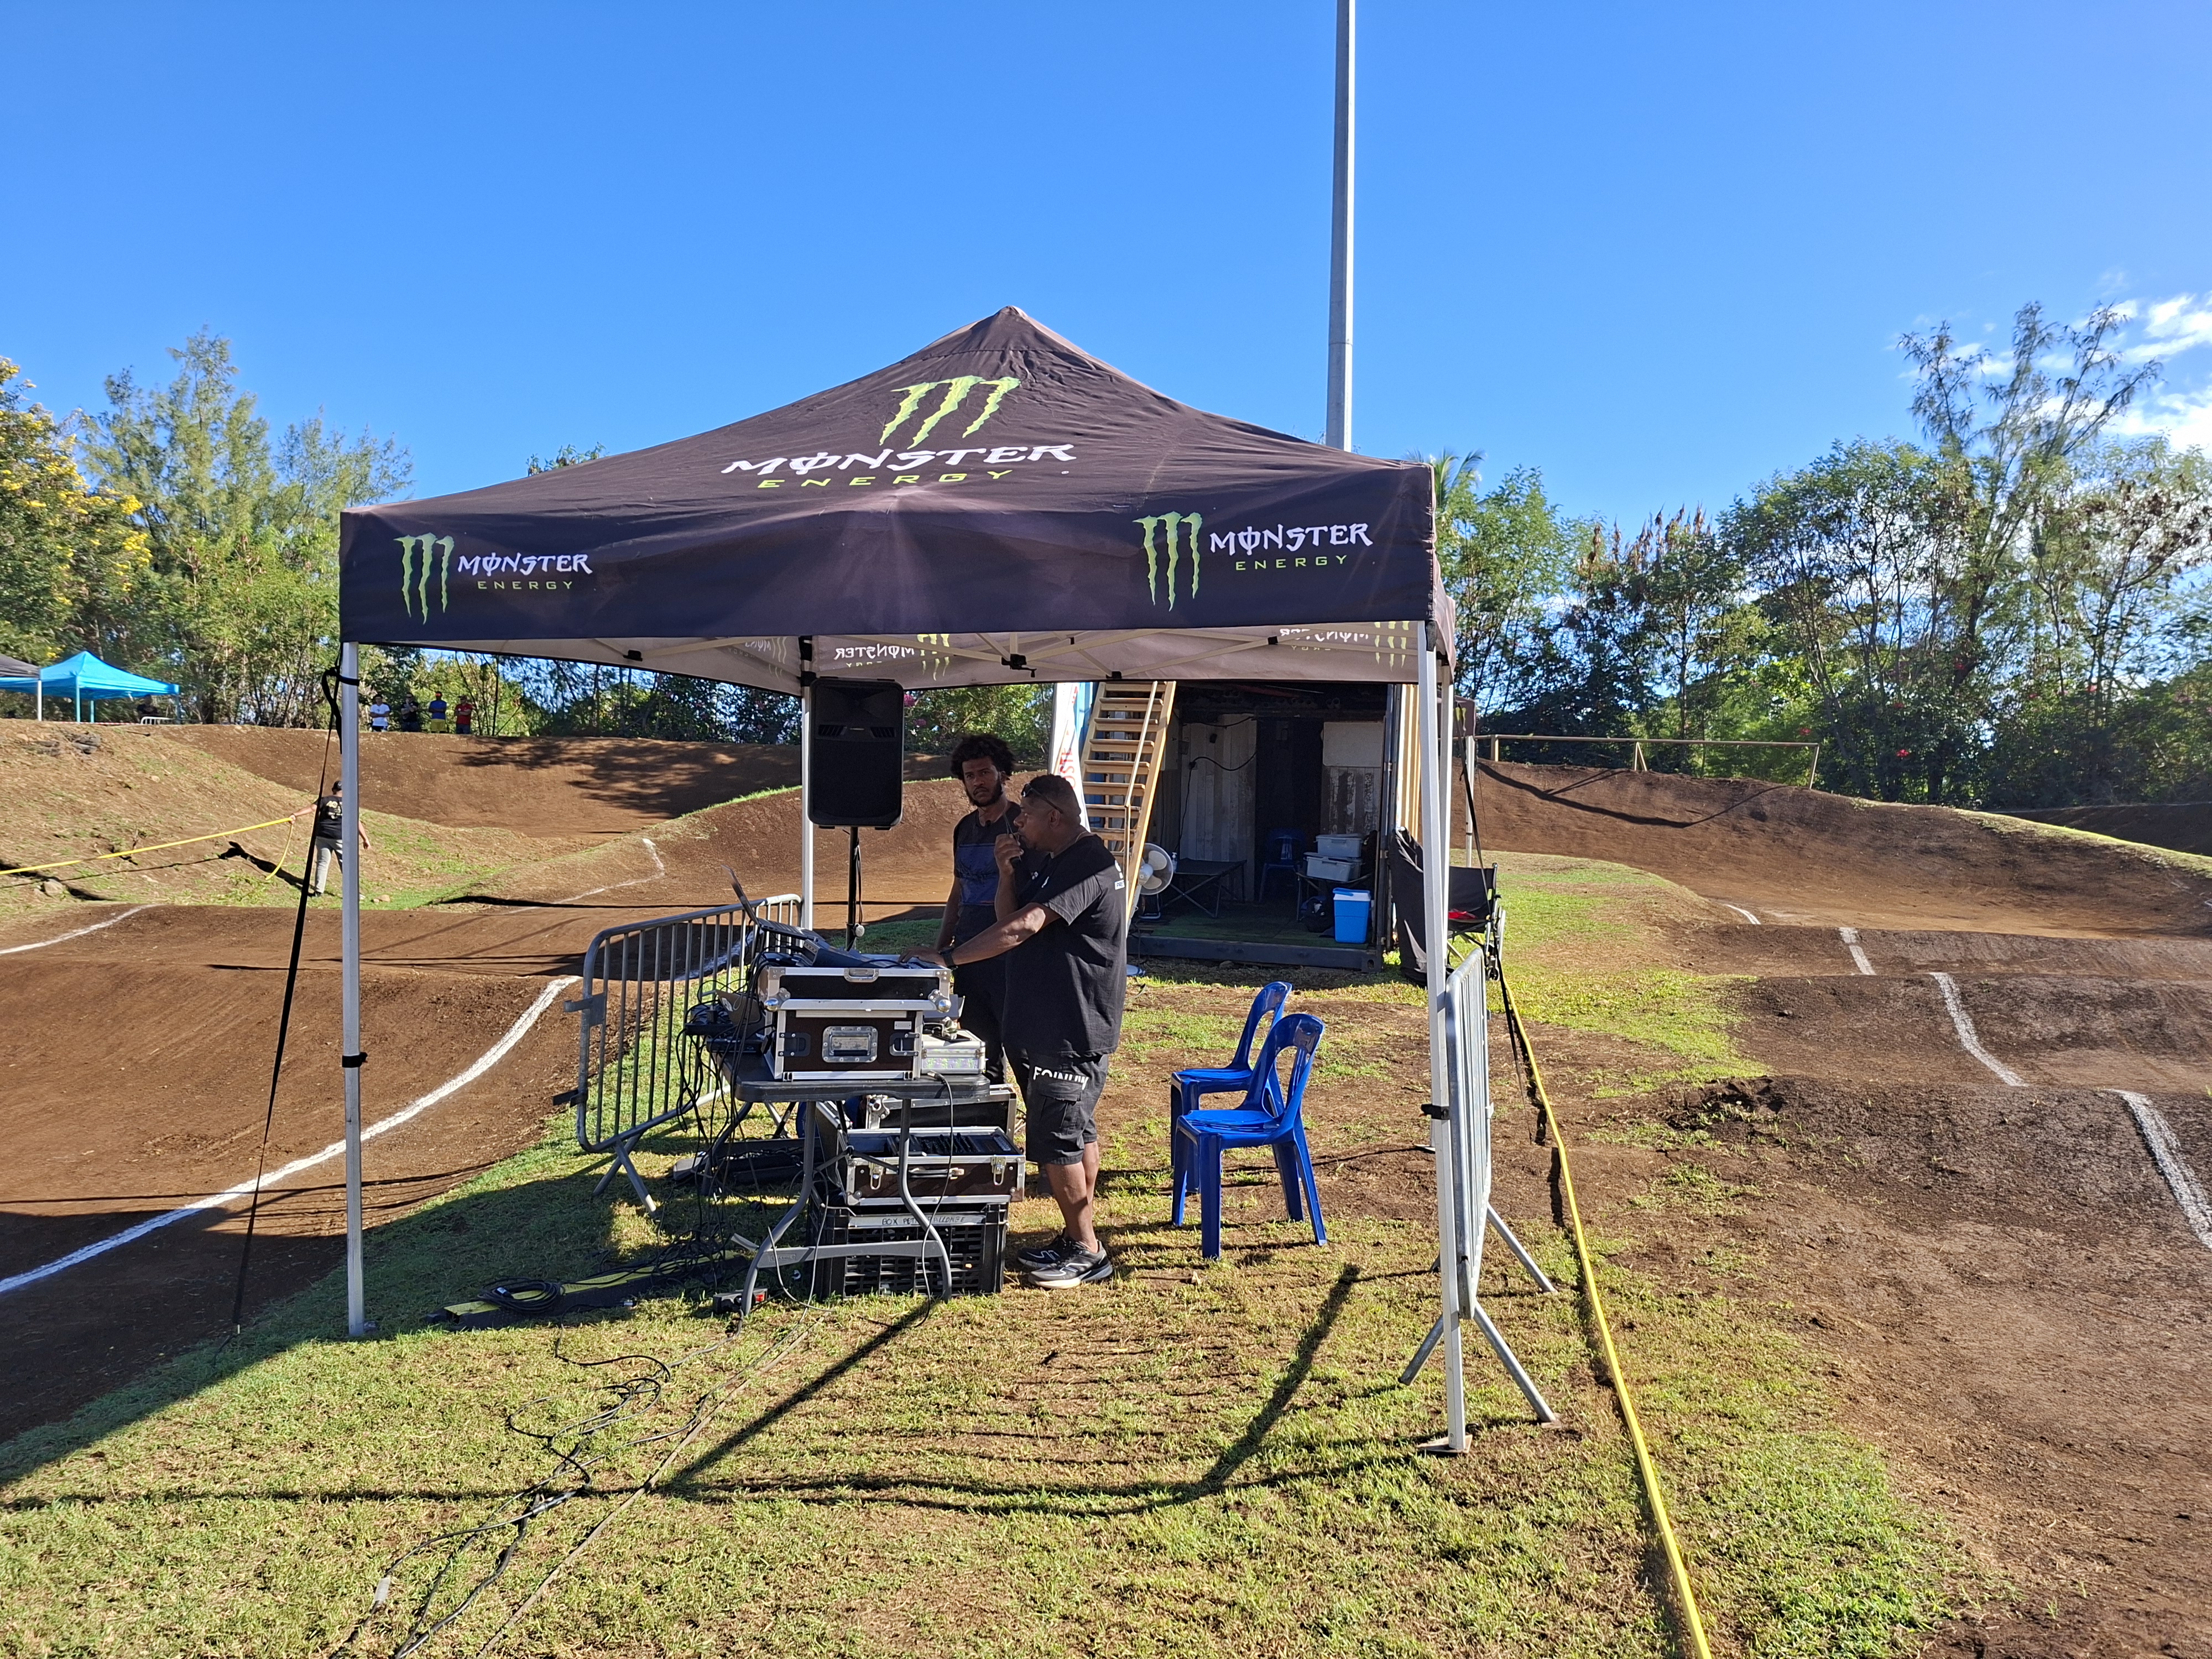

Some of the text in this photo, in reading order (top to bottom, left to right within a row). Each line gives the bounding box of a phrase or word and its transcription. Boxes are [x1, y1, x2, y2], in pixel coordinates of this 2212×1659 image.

[721, 444, 1077, 475] MONSTER
[758, 470, 1013, 488] ENERGY
[1209, 523, 1374, 556] MONSTER
[457, 552, 593, 577] MONSTER
[1235, 555, 1348, 571] ENERGY
[477, 581, 573, 590] ENERGY
